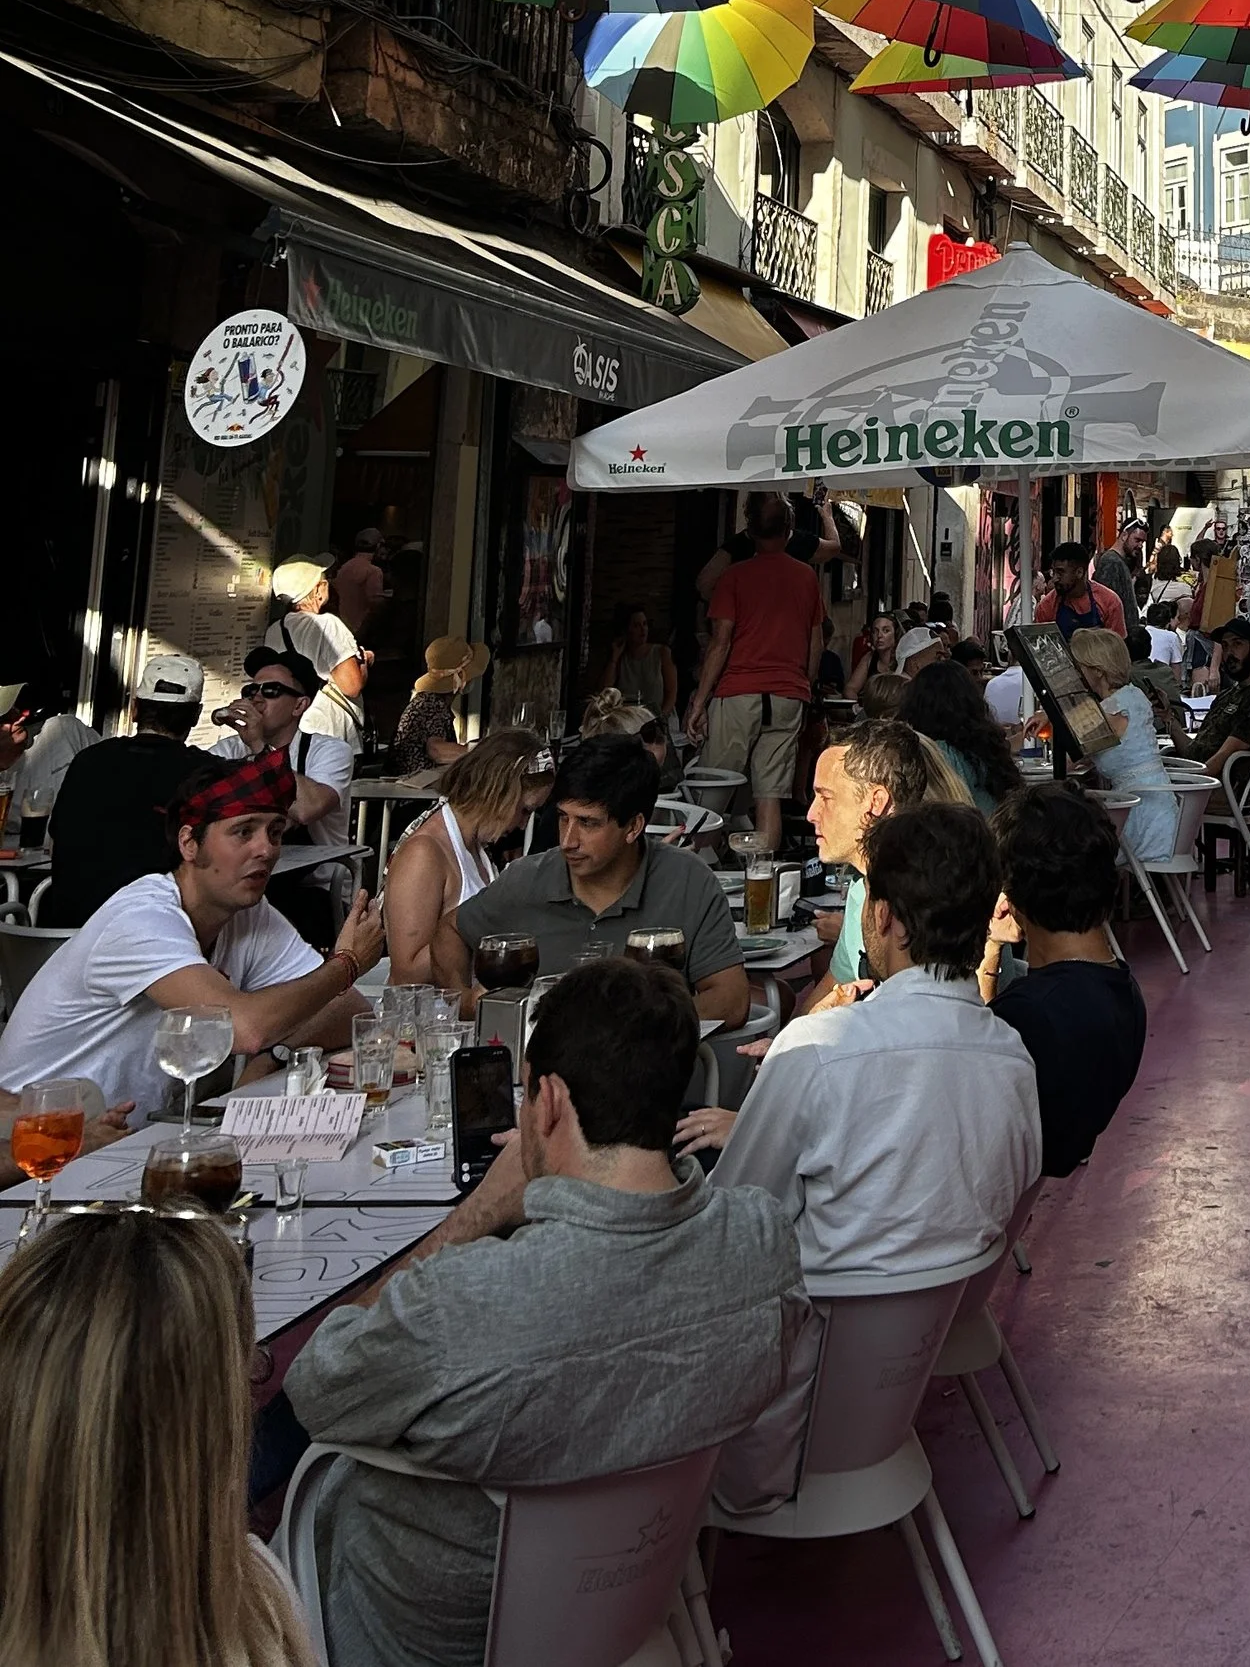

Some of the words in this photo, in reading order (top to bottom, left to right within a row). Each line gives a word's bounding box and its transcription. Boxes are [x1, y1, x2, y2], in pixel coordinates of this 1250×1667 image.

[326, 277, 419, 340] Heineken
[222, 339, 229, 349] O
[231, 334, 281, 349] BAILARICO?
[223, 324, 259, 336] PRONTO
[260, 321, 283, 334] PARA
[573, 337, 621, 393] OASIS
[782, 409, 1075, 473] Heineken
[608, 462, 666, 475] Heineken
